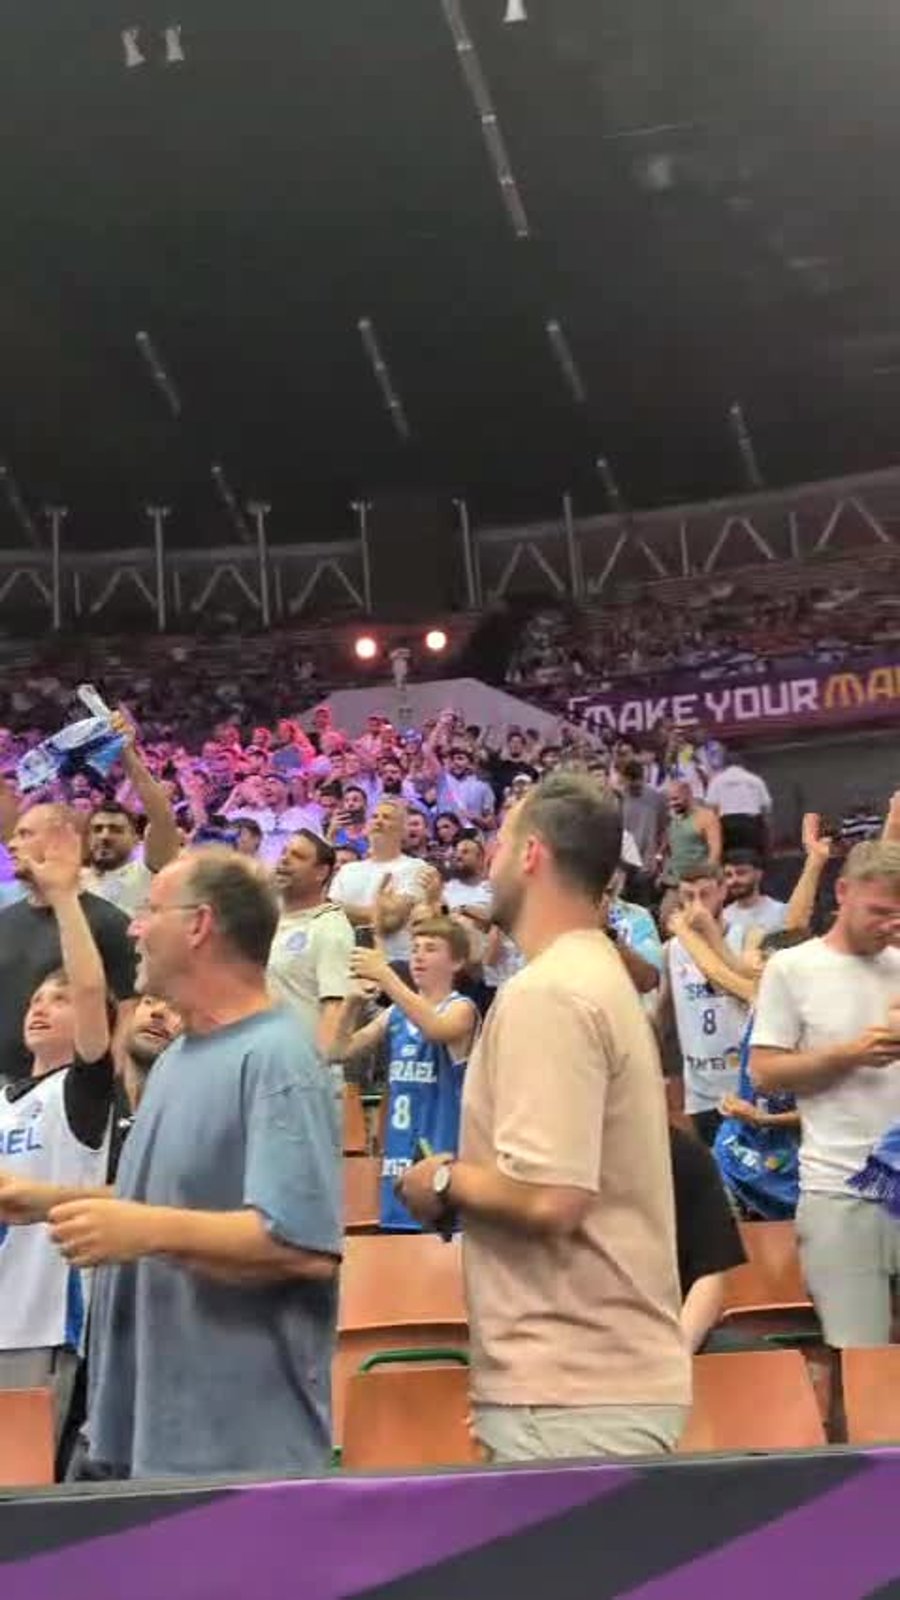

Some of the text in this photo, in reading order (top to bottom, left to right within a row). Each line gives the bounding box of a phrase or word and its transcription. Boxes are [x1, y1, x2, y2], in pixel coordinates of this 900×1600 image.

[582, 694, 699, 735] MAKE
[705, 678, 819, 722] YOUR
[702, 1008, 717, 1035] 8
[391, 1094, 412, 1130] 8
